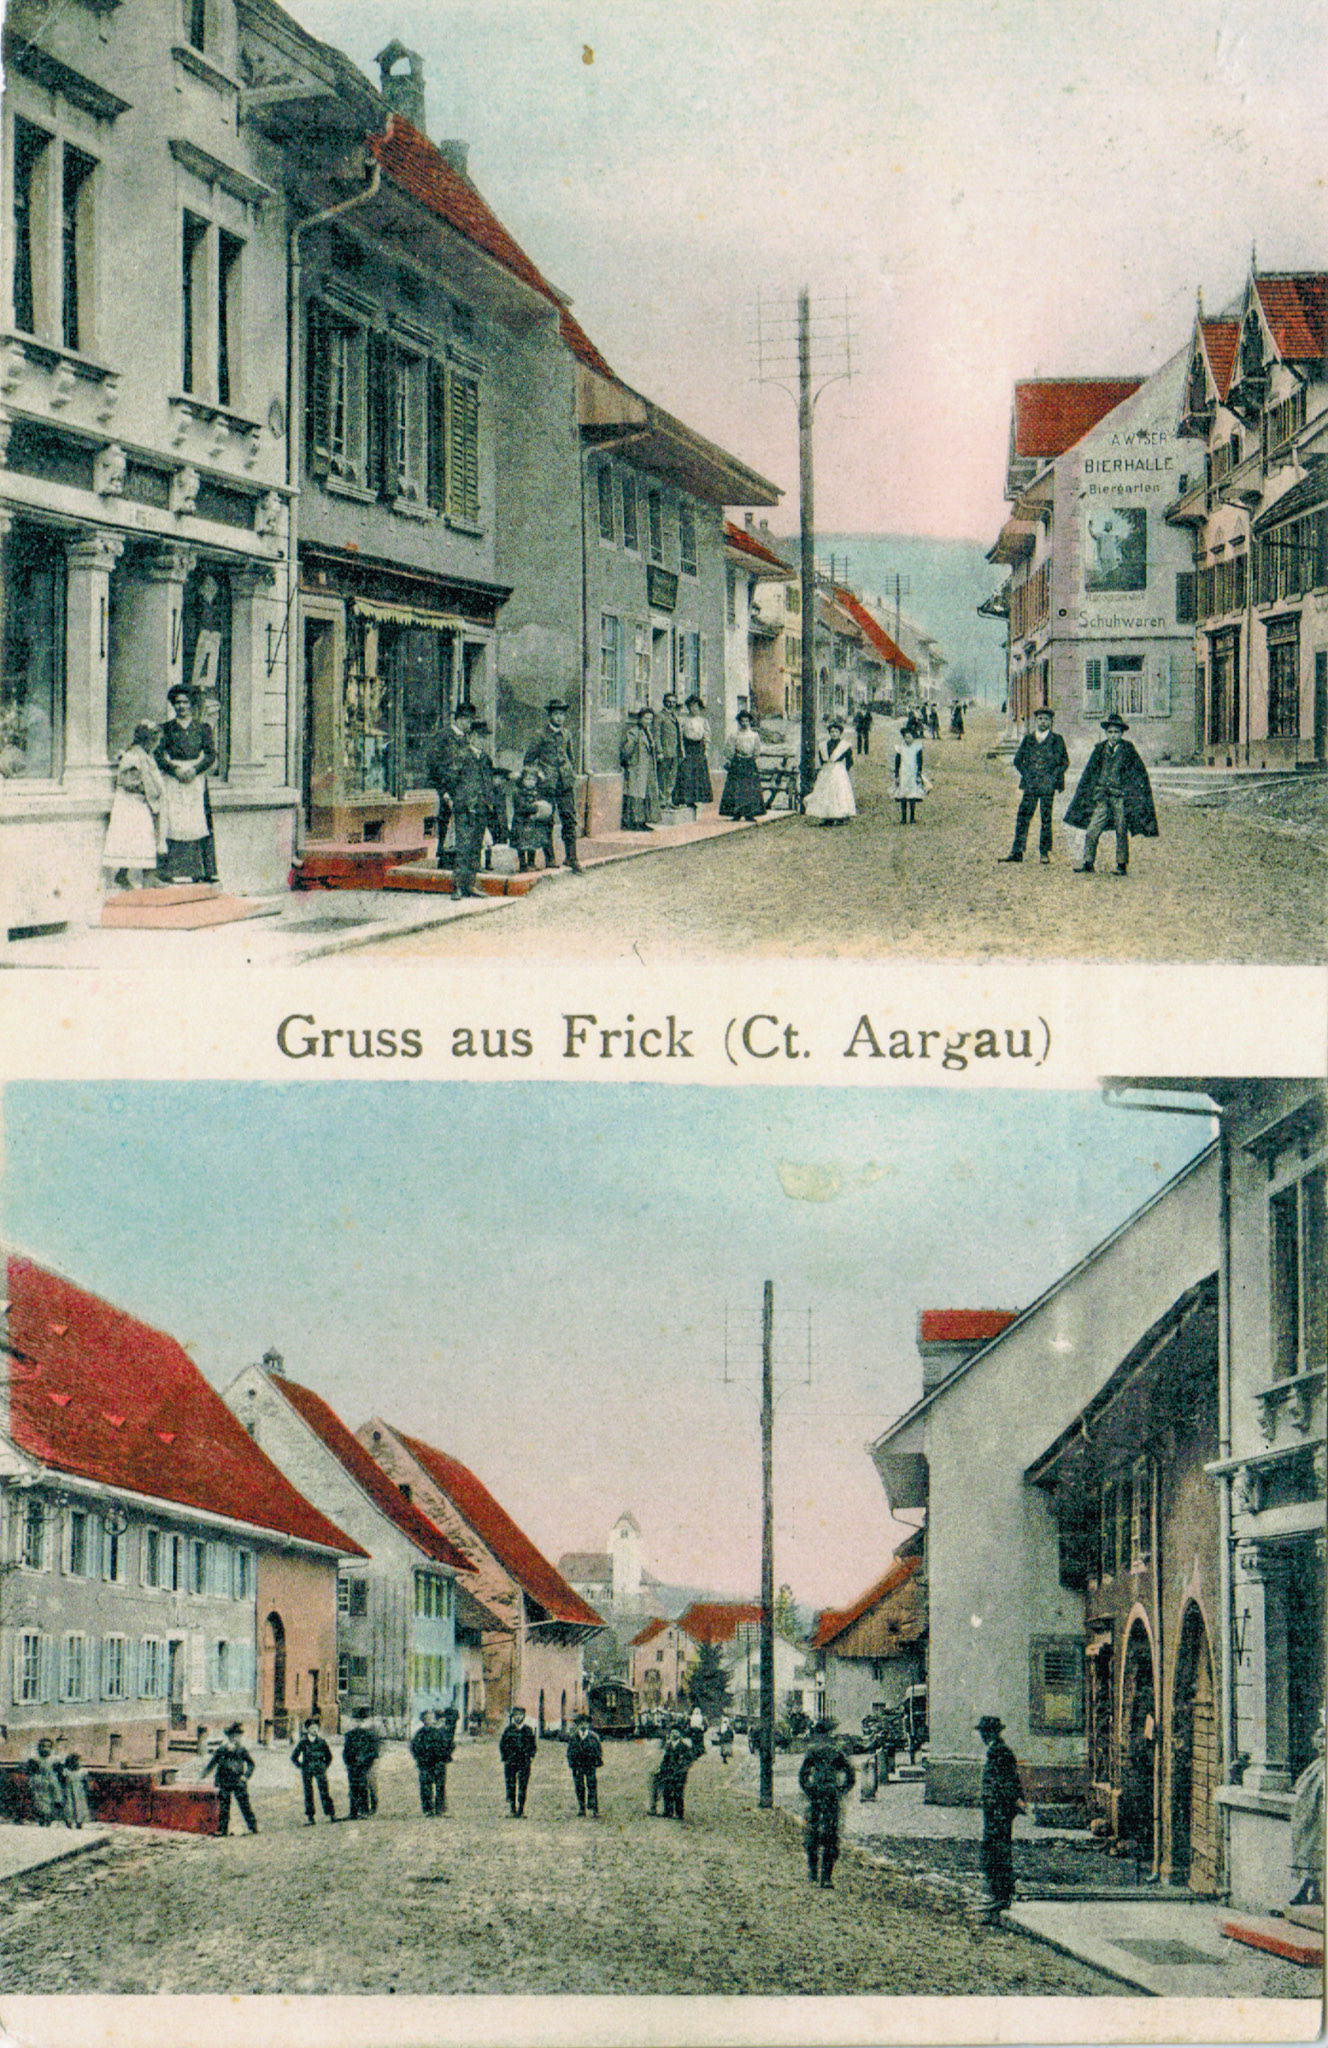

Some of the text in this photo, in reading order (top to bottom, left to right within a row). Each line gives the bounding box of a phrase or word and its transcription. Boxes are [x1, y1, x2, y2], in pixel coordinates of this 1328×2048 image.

[1085, 457, 1174, 473] BIERHALLE
[1089, 483, 1160, 495] Biergarten
[1079, 610, 1166, 628] Schuhwaren
